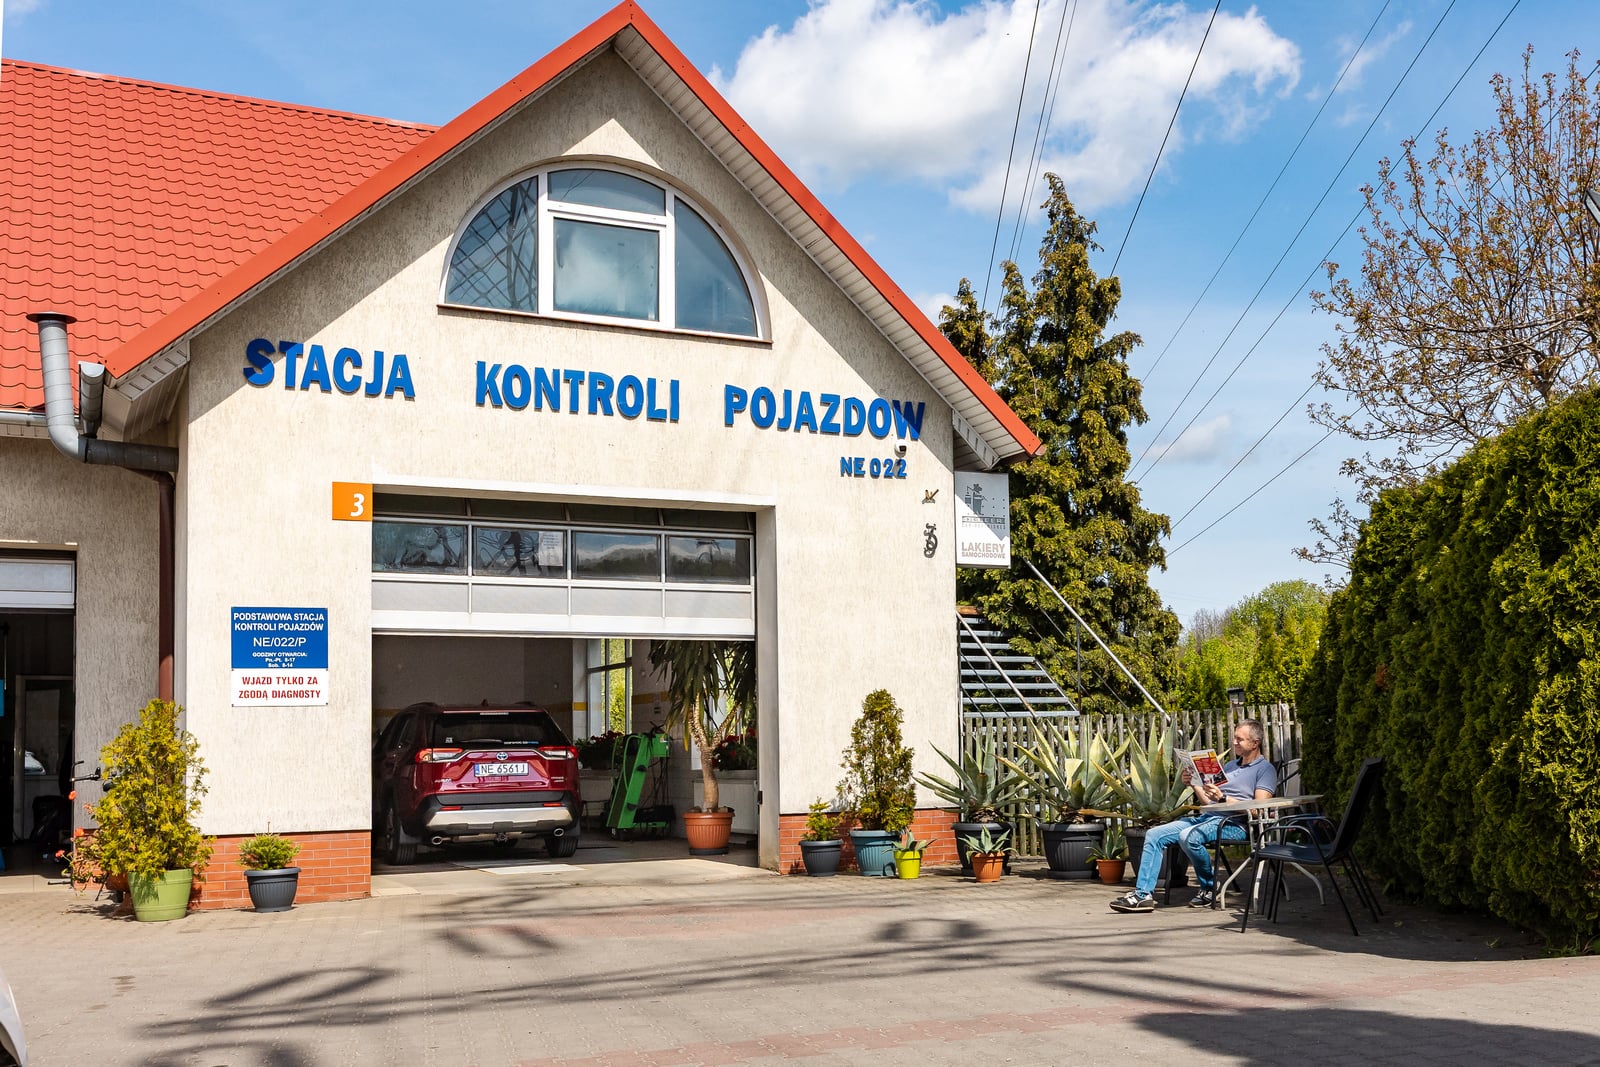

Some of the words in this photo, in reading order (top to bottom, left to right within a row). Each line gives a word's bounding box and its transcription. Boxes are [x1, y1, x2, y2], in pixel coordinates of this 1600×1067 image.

[243, 338, 416, 399] STACJA
[475, 360, 680, 422] KONTROLI
[724, 384, 926, 441] POJAZDOW
[840, 456, 866, 477] NE
[869, 457, 908, 479] 022
[349, 493, 365, 517] 3
[961, 541, 1006, 553] LAKIERY
[961, 551, 1006, 559] SAMOCHODOWE
[233, 612, 292, 621] PODSTAWOWA
[293, 613, 325, 621] STACJA
[234, 623, 277, 631] KONTROLI
[278, 622, 324, 631] POJAZDÓW
[253, 637, 307, 647] NE/022/P
[241, 676, 272, 685] WJAZD
[276, 676, 304, 685] TYLKO
[307, 676, 318, 685] ZA
[238, 690, 268, 700] ZGODĄ
[271, 689, 321, 699] DIAGNOSTY
[481, 764, 494, 774] NE
[496, 764, 525, 774] 6561J
